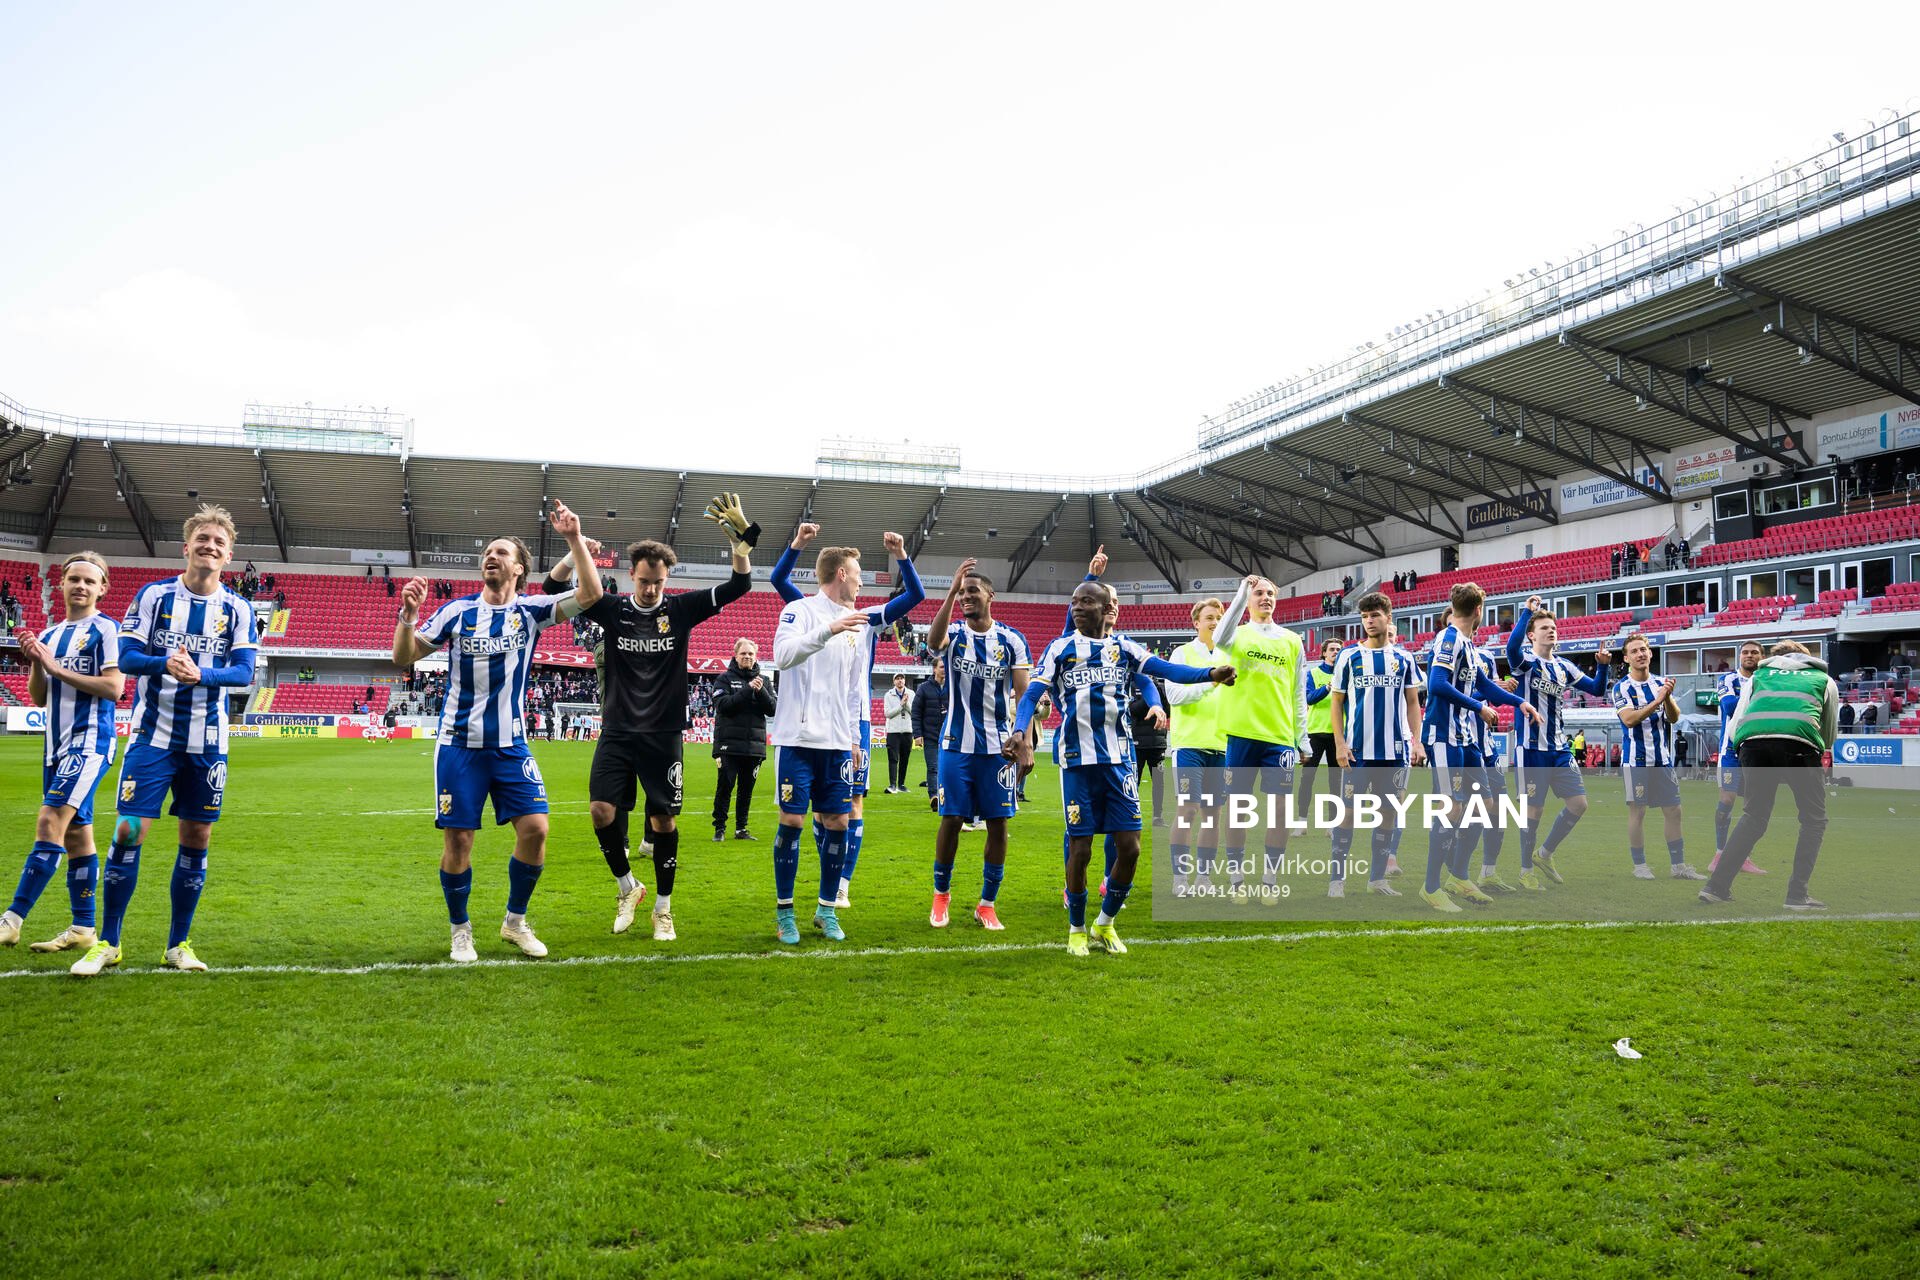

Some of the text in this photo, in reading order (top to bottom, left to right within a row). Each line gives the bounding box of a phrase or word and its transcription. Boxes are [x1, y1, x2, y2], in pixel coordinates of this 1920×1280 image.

[1592, 488, 1625, 504] Kalmar
[429, 553, 471, 564] inside
[797, 570, 811, 578] IVT
[154, 630, 229, 656] SERNEKE
[461, 631, 527, 655] SERNEKE
[617, 637, 676, 653] SERNEKE
[1247, 650, 1280, 664] CRAFT
[953, 656, 1008, 680] SERNEKE
[1063, 666, 1126, 688] SERNEKE
[1354, 674, 1403, 689] SERNEKE
[255, 715, 318, 726] GuldFågeln
[281, 726, 318, 735] HYLTE
[1860, 745, 1893, 754] GLEBES
[57, 778, 67, 790] 7
[212, 793, 221, 805] 15
